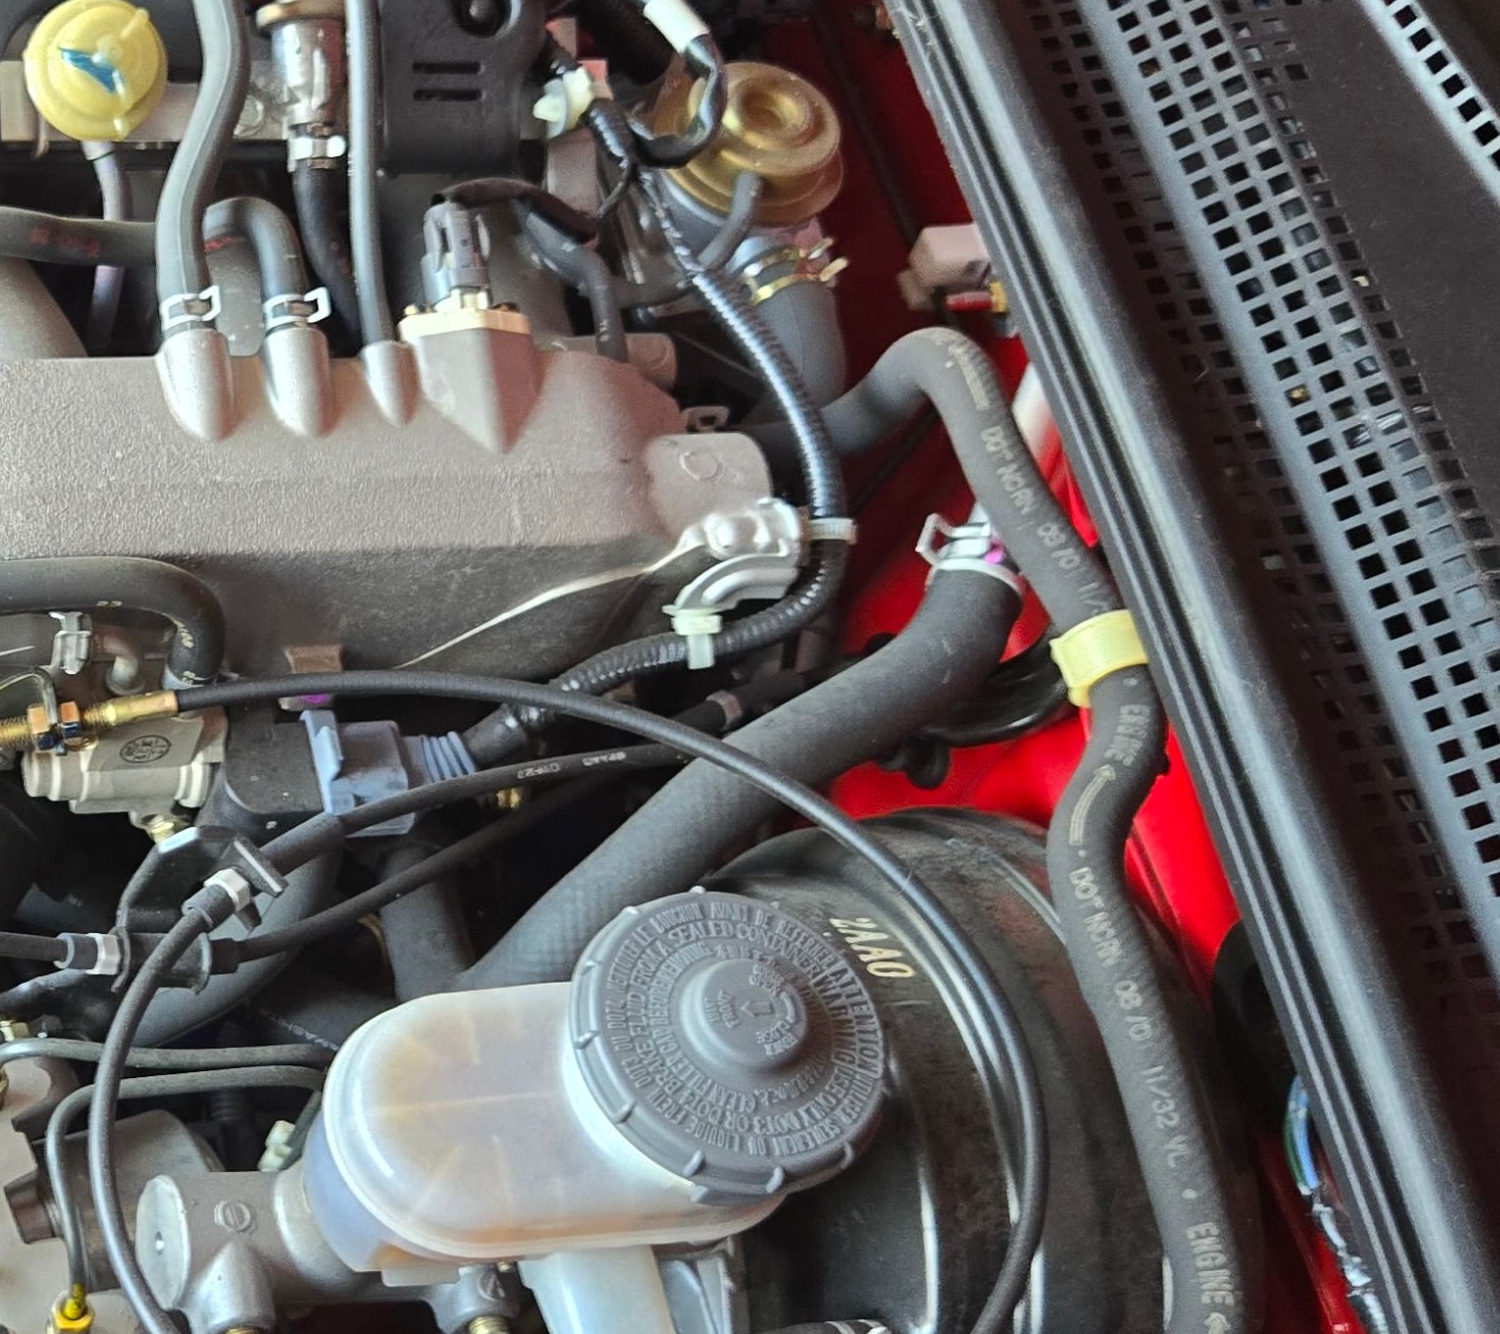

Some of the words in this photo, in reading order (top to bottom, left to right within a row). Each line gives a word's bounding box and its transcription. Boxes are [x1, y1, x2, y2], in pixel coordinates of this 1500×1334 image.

[629, 922, 657, 947] LE
[664, 921, 734, 948] SEALED
[753, 907, 773, 930] DE
[652, 937, 674, 956] A
[736, 923, 825, 980] CONTAINER
[628, 947, 663, 989] FROM
[626, 990, 649, 1036] FLUID
[811, 975, 858, 1067] WARNING
[828, 965, 880, 1073] ATTENTION
[649, 1025, 681, 1055] CAP
[619, 1055, 652, 1087] DOT3
[633, 1040, 683, 1095] BRAKE
[662, 1050, 712, 1096] FILLER
[825, 1065, 853, 1098] USE
[677, 1088, 723, 1125] DOT4
[706, 1083, 758, 1114] CLEAN
[795, 1089, 840, 1126] ONLY
[684, 1115, 739, 1152] LIQUIDE
[723, 1109, 749, 1132] OR
[752, 1110, 802, 1133] DOT3
[1186, 1221, 1235, 1307] ENGINE
